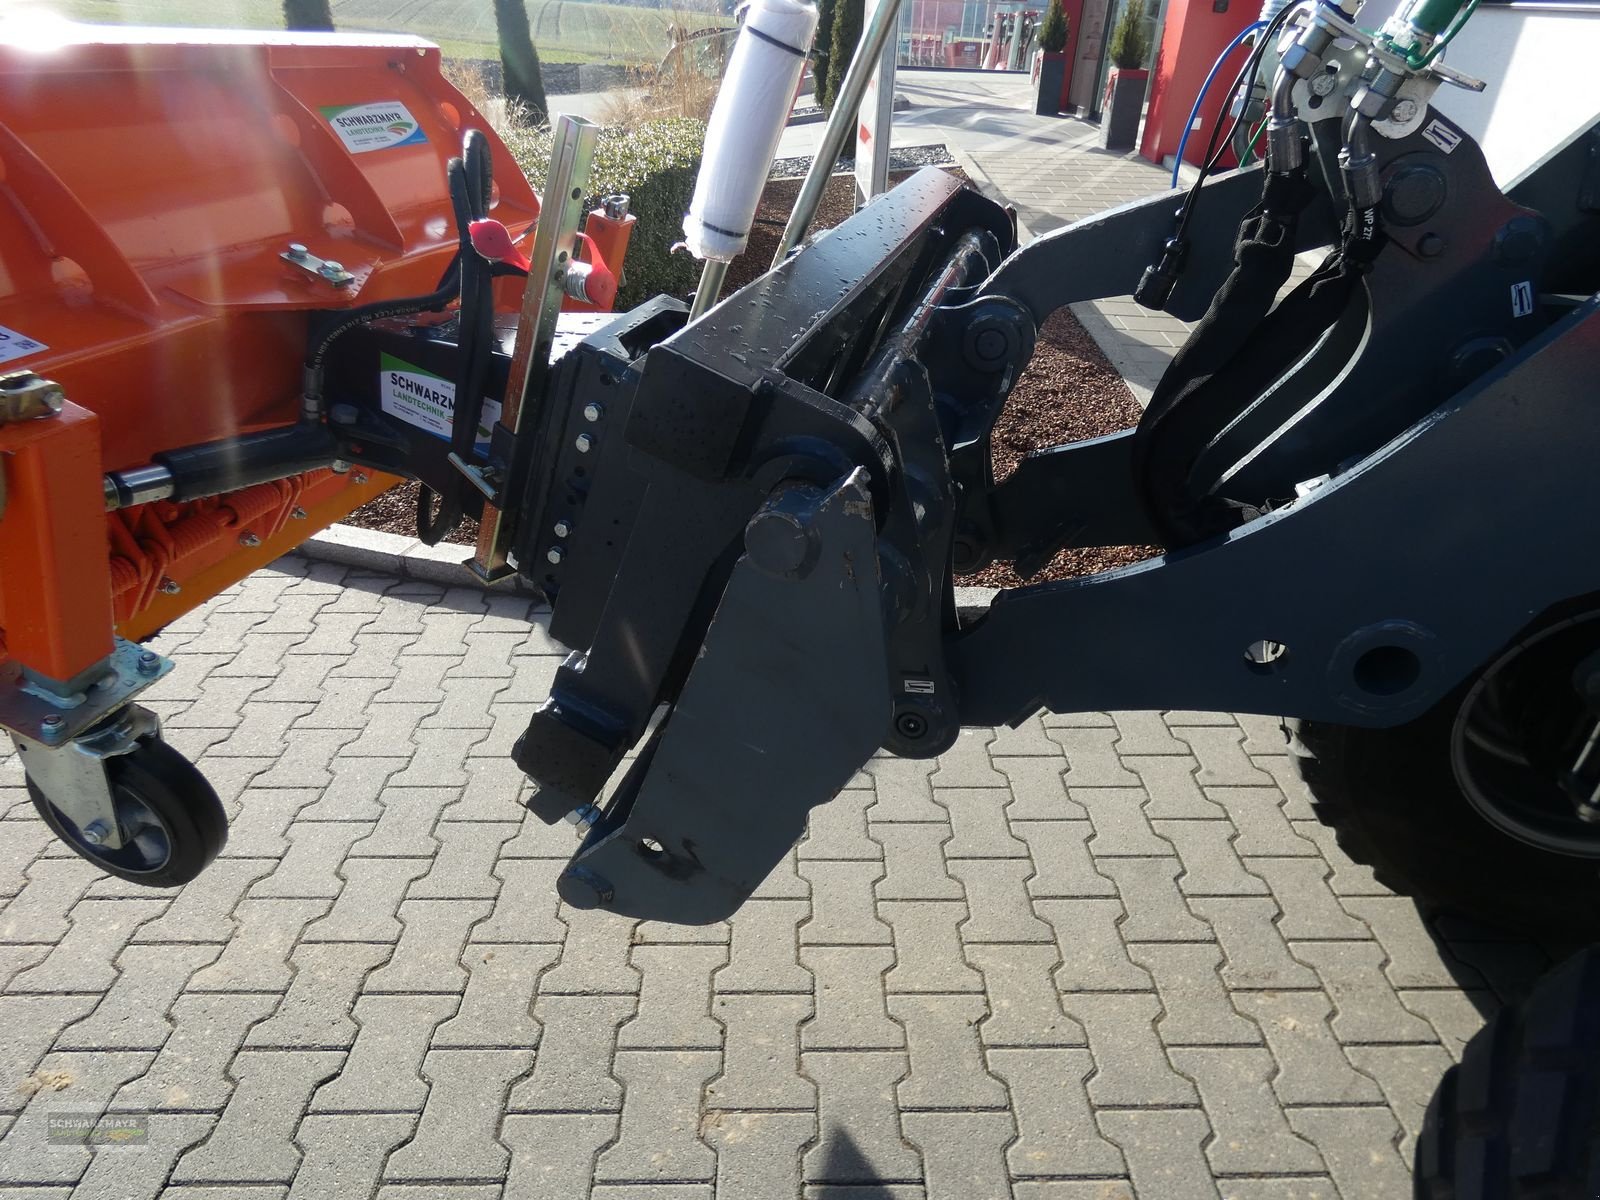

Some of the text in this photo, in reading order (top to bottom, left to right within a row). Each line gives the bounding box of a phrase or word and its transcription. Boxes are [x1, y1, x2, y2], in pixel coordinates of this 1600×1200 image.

[336, 112, 403, 128] SCHWARZMAYR
[1364, 207, 1374, 225] WP
[390, 372, 456, 411] SCHWARZM
[392, 389, 446, 420] LANDTECHNIK
